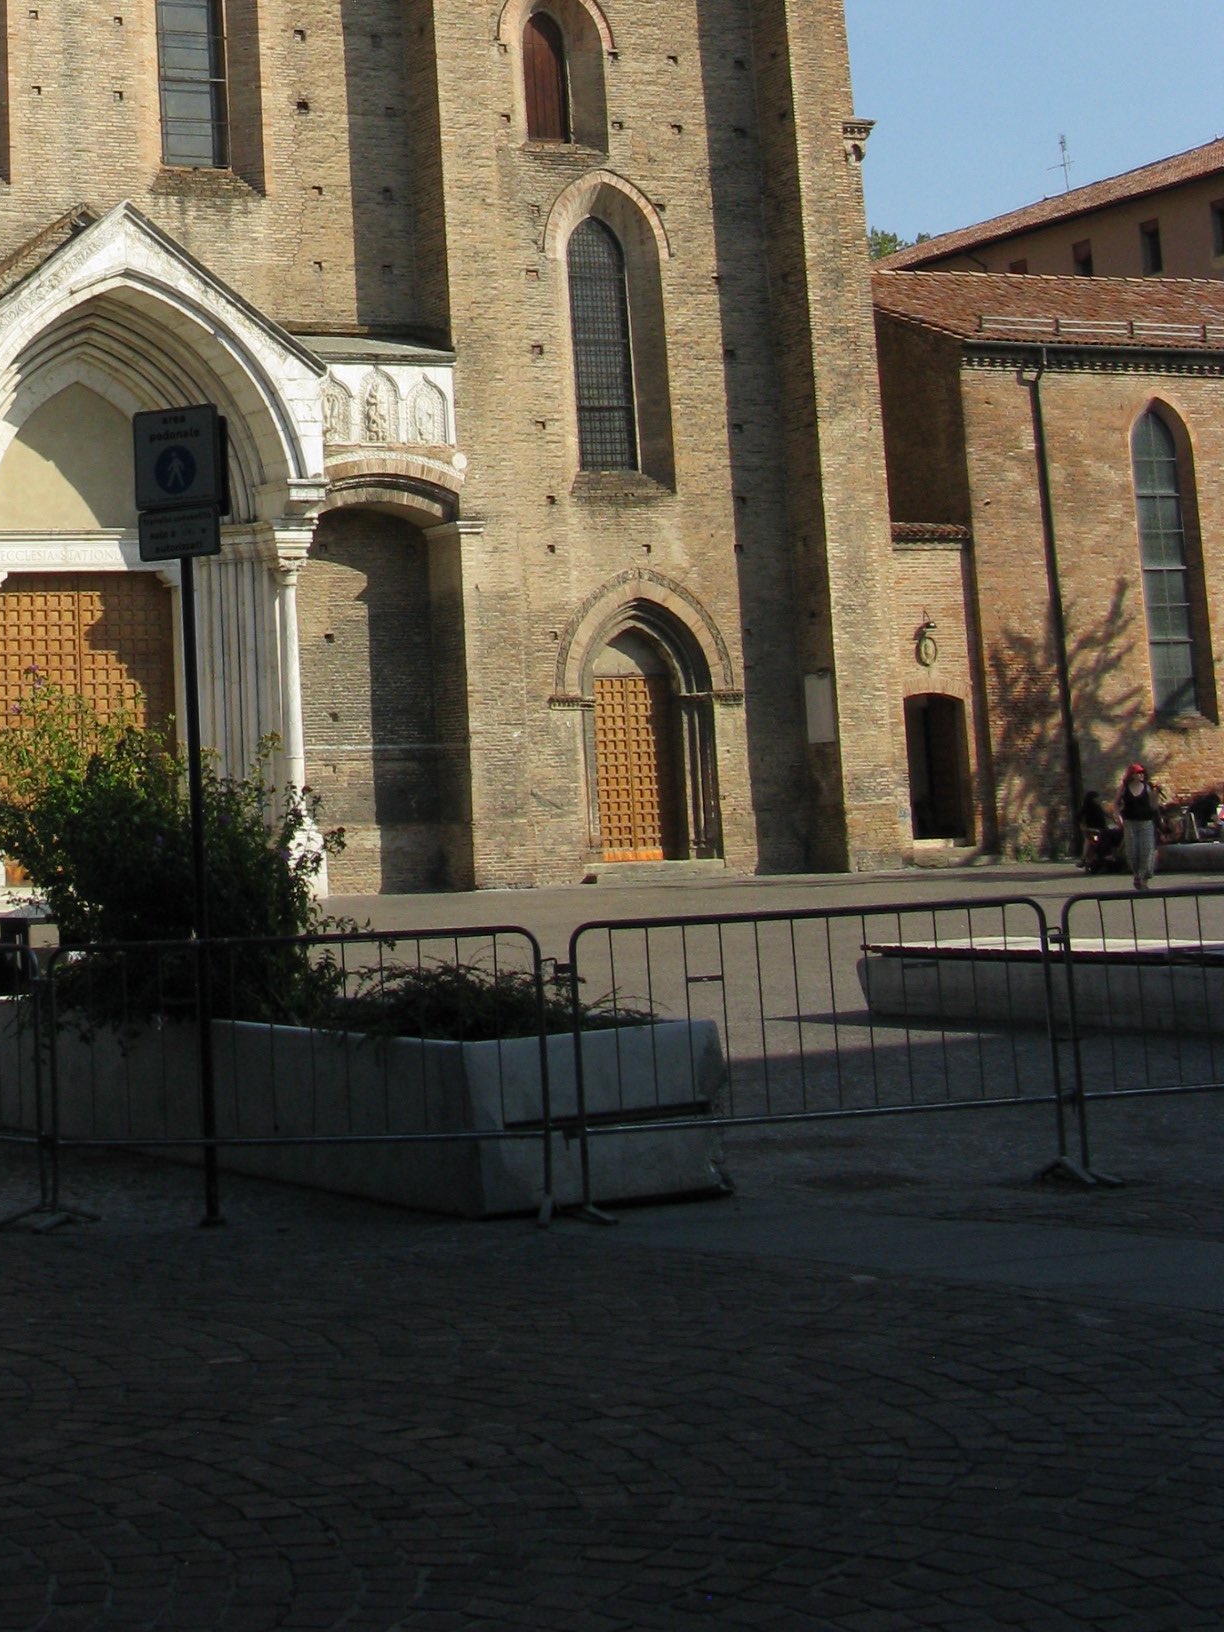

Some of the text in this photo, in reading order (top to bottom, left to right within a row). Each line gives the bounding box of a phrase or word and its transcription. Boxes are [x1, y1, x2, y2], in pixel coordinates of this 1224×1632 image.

[162, 415, 186, 424] area
[150, 427, 200, 443] pedonale
[0, 549, 55, 561] ECCLESIA
